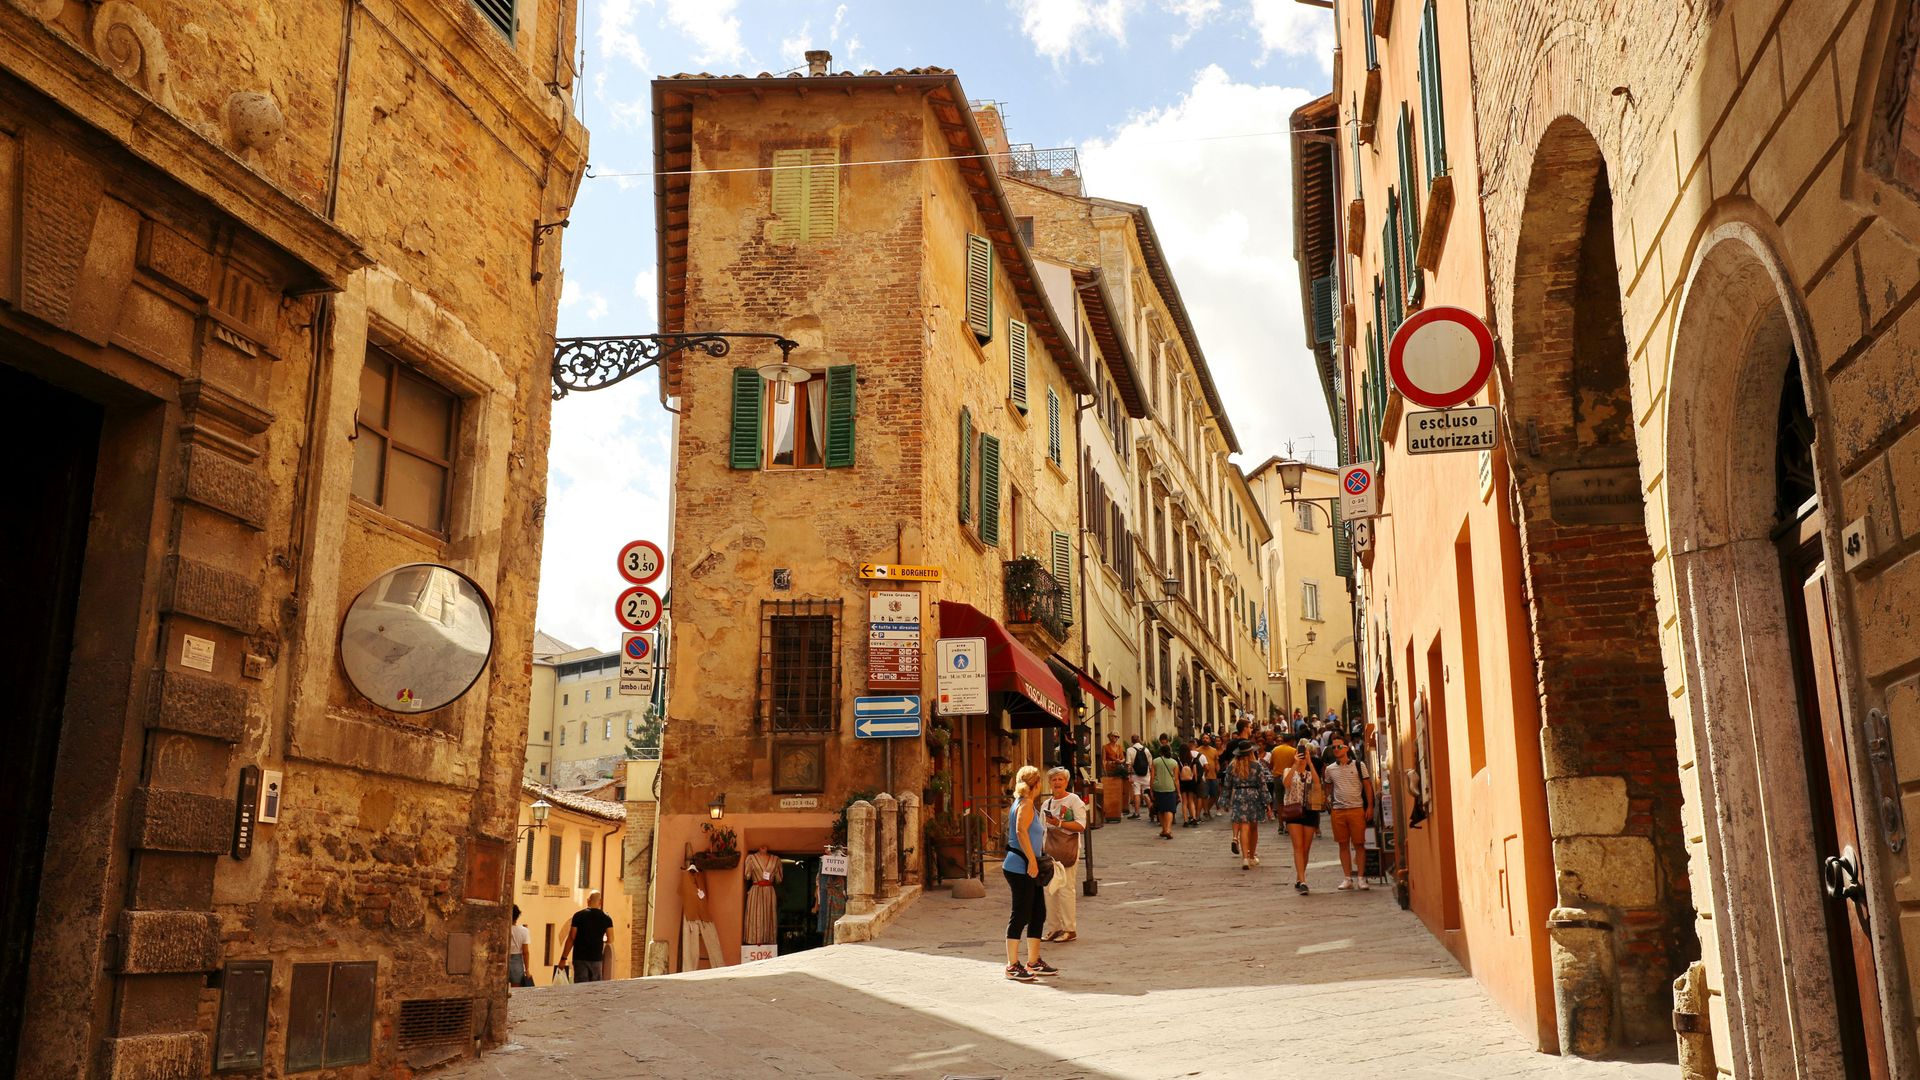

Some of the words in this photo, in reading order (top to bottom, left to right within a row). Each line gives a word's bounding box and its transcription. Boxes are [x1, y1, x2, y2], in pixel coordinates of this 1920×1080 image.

[1419, 413, 1478, 430] escluso
[1411, 430, 1493, 450] autorizzati
[1583, 478, 1616, 488] VIA
[1847, 532, 1861, 557] 45
[890, 568, 897, 576] IL
[901, 568, 939, 577] BORGHETTO
[1336, 660, 1345, 668] LA
[1024, 682, 1047, 710] TOSCAN
[1047, 699, 1063, 719] PELLE
